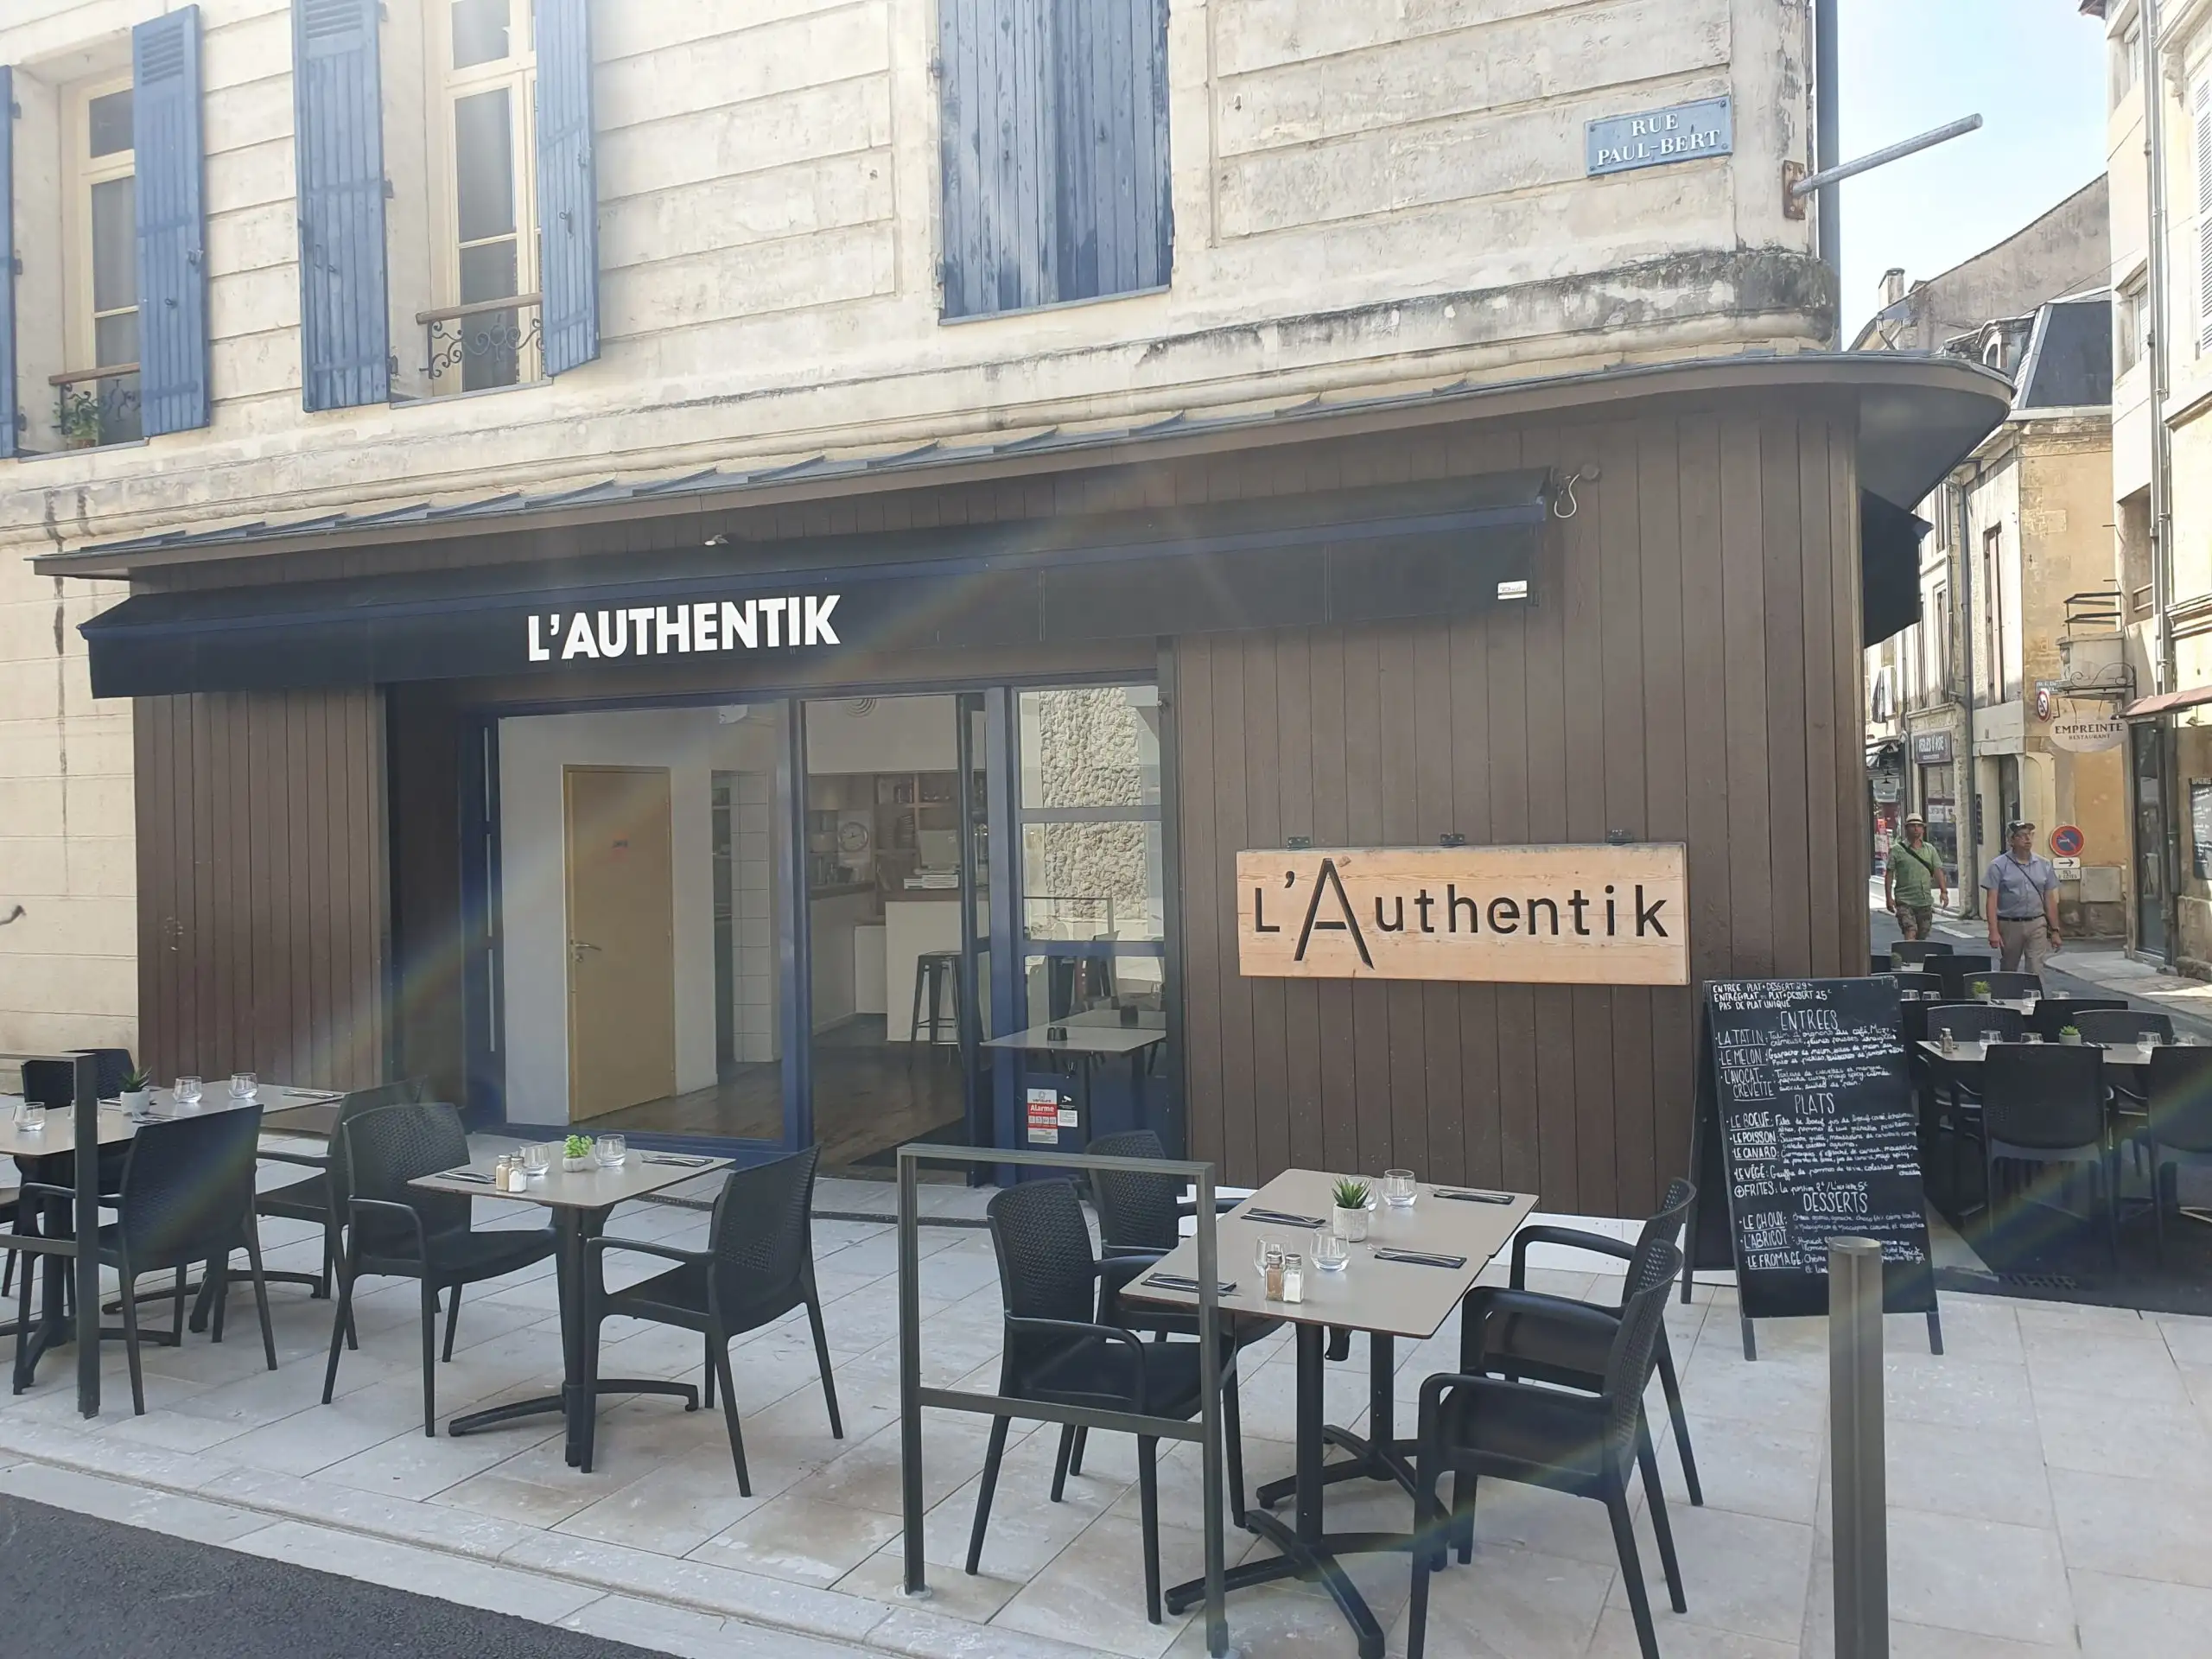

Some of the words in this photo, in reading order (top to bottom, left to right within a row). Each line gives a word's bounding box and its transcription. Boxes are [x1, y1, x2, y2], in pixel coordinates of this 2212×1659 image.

[1631, 113, 1679, 137] RUE
[1597, 129, 1721, 166] PAUL-BERT
[528, 594, 842, 662] L'AUTHENTIK
[2055, 723, 2123, 734] EMPREINTE
[1255, 857, 1670, 970] L'Authentik
[1719, 1001, 1732, 1011] PAS
[1747, 1000, 1762, 1009] PLAT
[1764, 999, 1790, 1009] UNIQUE
[1718, 1031, 1731, 1046] LA
[1721, 1050, 1732, 1065] LE
[1734, 1048, 1763, 1065] MELON
[1795, 1093, 1834, 1115] PLATS
[1731, 1115, 1741, 1128] LE
[1732, 1133, 1742, 1143] LE
[1742, 1131, 1776, 1143] POISSON
[1734, 1147, 1742, 1159] LE
[1803, 1192, 1868, 1213] DESSERTS
[1743, 1215, 1754, 1230] LE
[1747, 1255, 1758, 1268] LE
